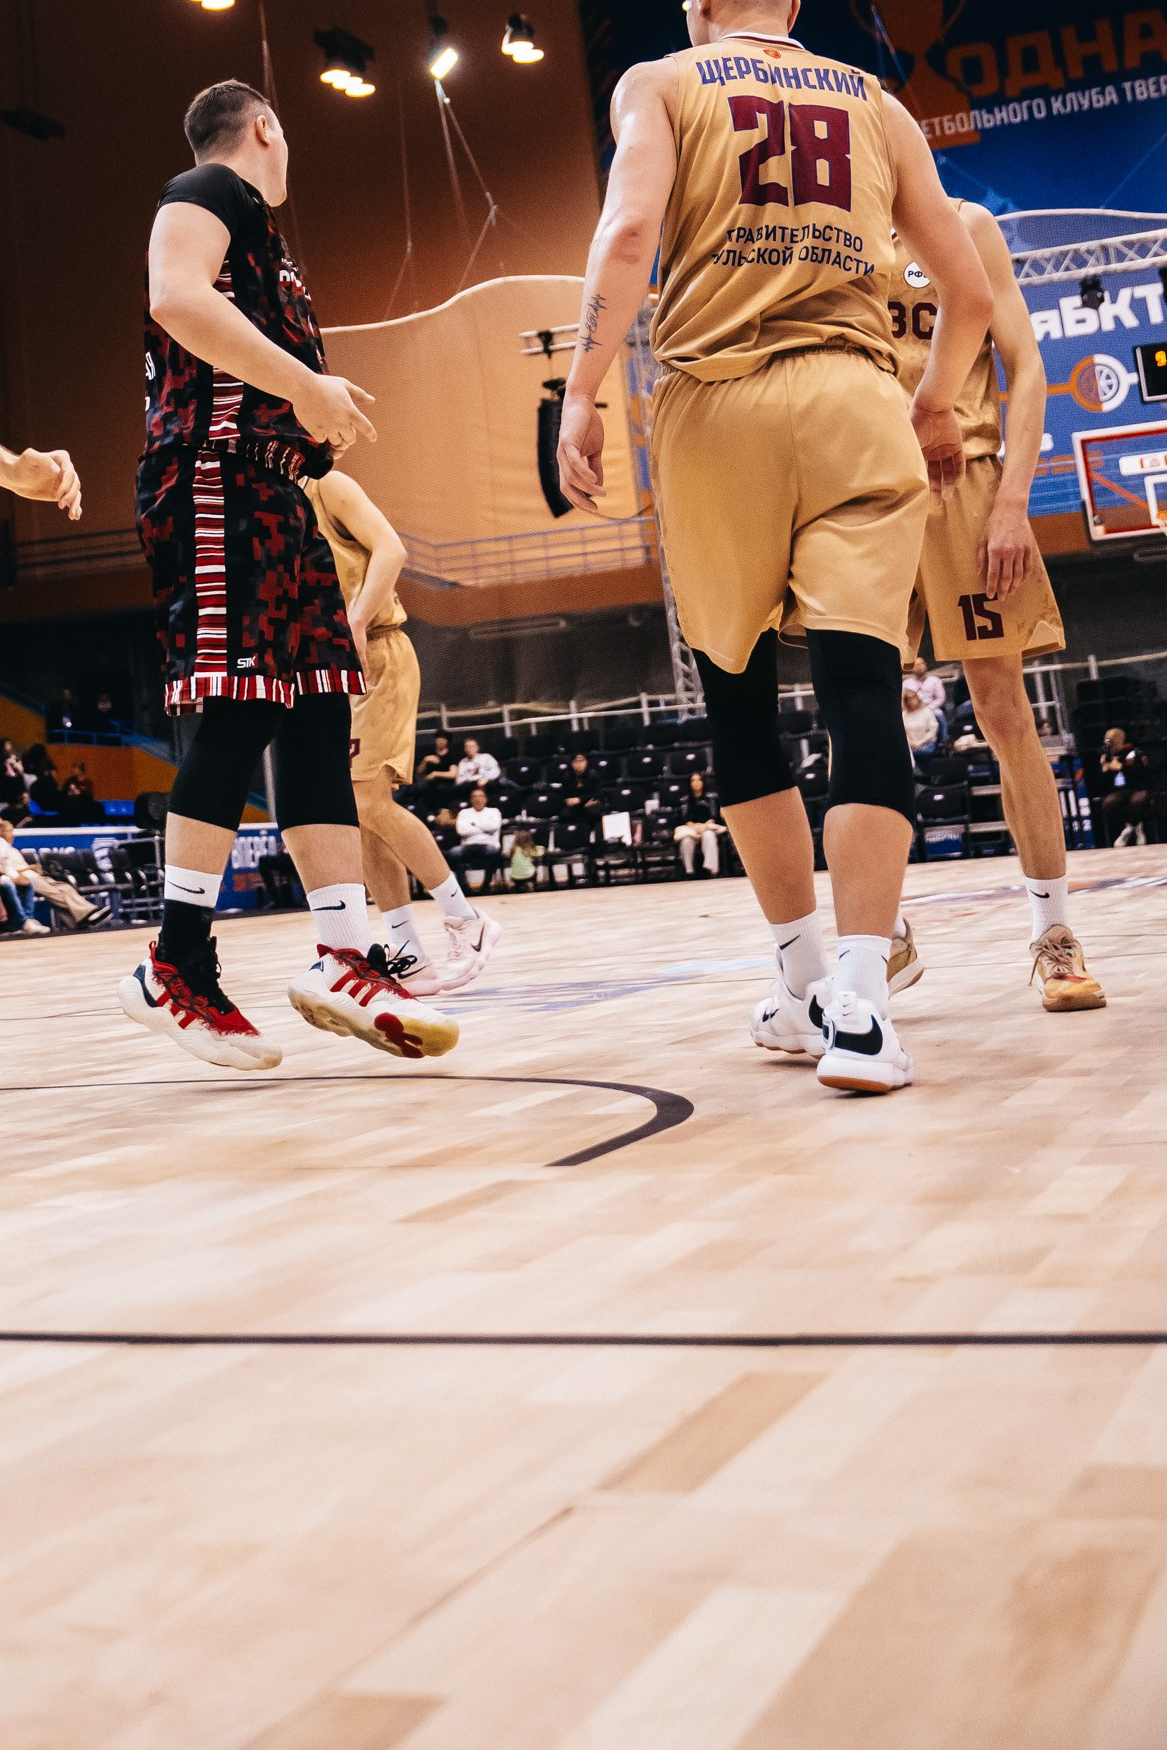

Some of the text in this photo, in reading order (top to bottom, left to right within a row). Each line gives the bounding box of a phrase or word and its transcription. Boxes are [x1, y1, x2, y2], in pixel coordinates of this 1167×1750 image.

[695, 56, 868, 101] ЩЕРБИНСКИЙ
[918, 98, 1047, 139] ЕТБОЛЬНОГО
[1050, 84, 1119, 116] КЛУБА
[727, 94, 852, 213] 28
[798, 245, 875, 276] ОБЛАСТИ
[907, 270, 926, 278] РФ
[958, 592, 1005, 641] 15
[236, 655, 256, 669] STK
